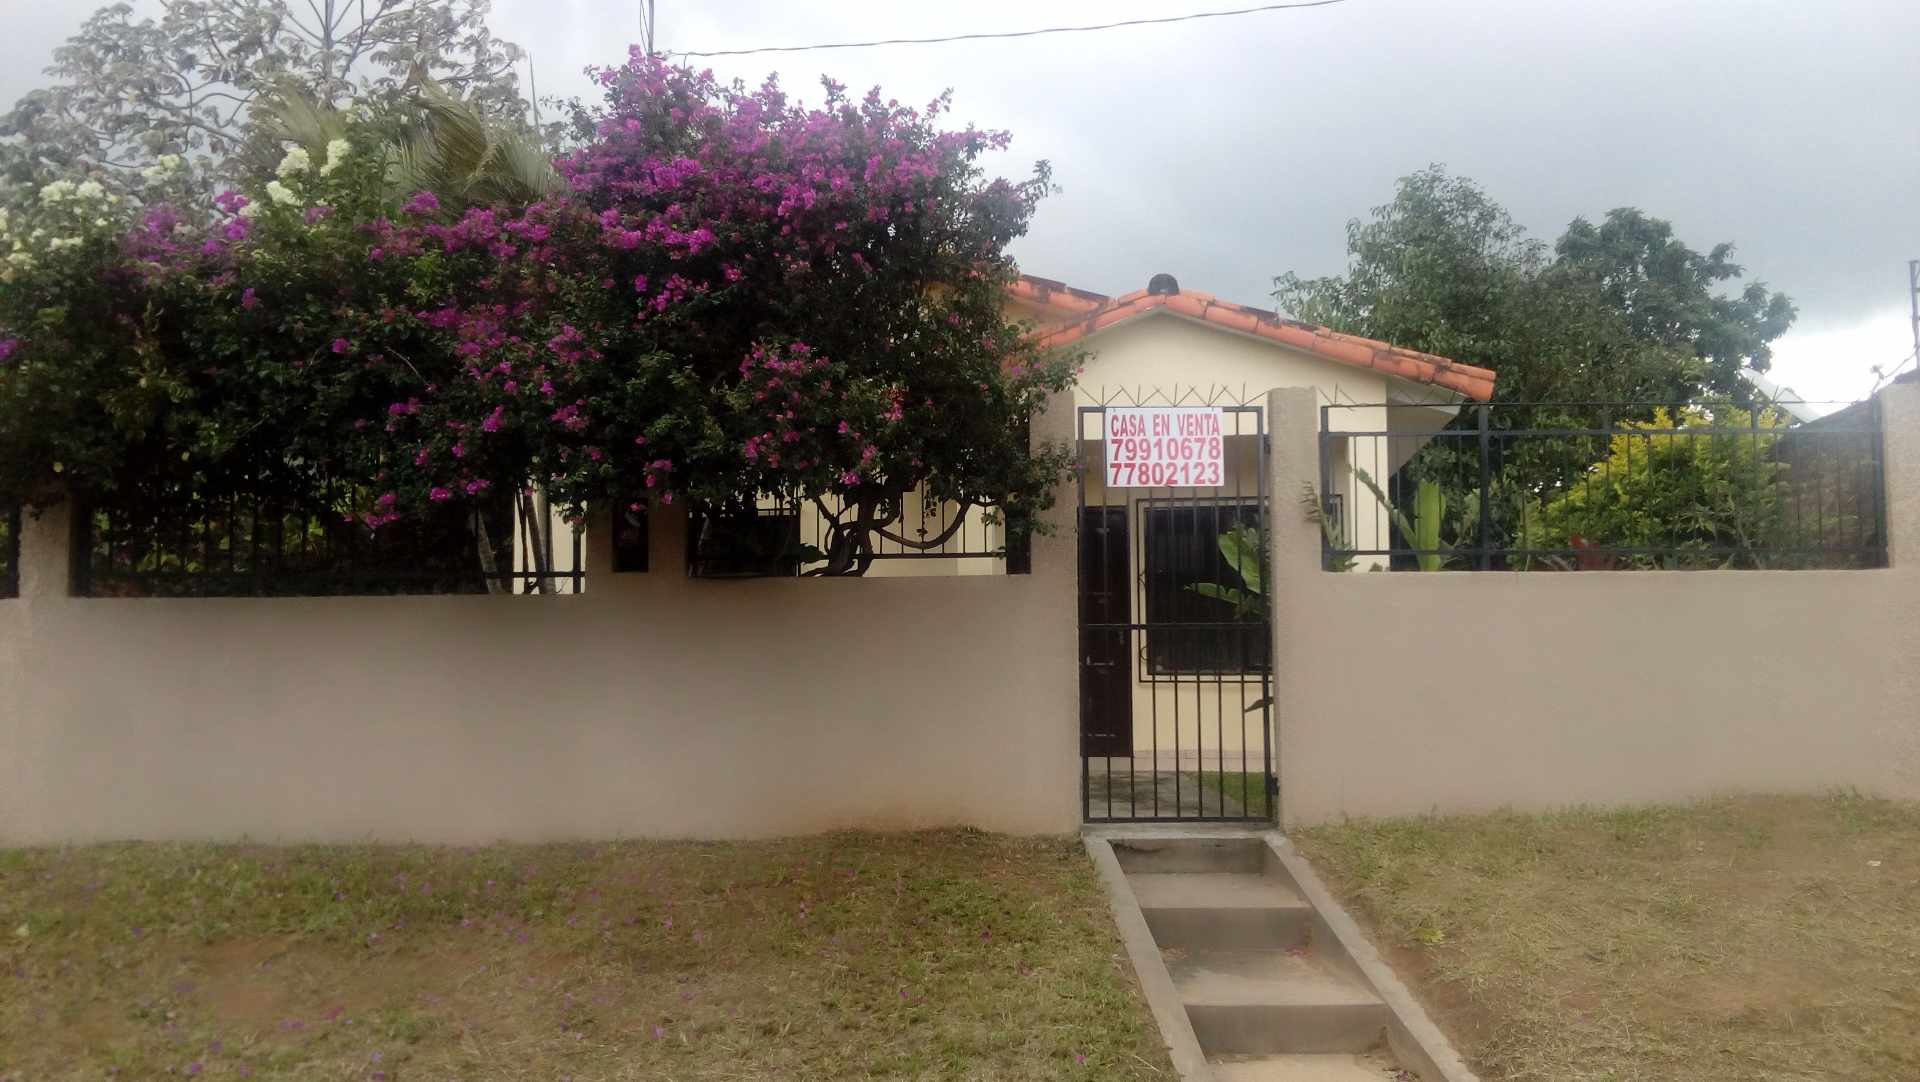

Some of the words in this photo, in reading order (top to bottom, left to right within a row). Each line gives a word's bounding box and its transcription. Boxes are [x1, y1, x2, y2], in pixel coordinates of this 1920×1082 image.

[1111, 414, 1146, 437] CASA
[1153, 414, 1170, 436] EN
[1177, 413, 1220, 436] VENTA
[1111, 437, 1221, 461] 79910678
[1110, 462, 1219, 485] 77802123
